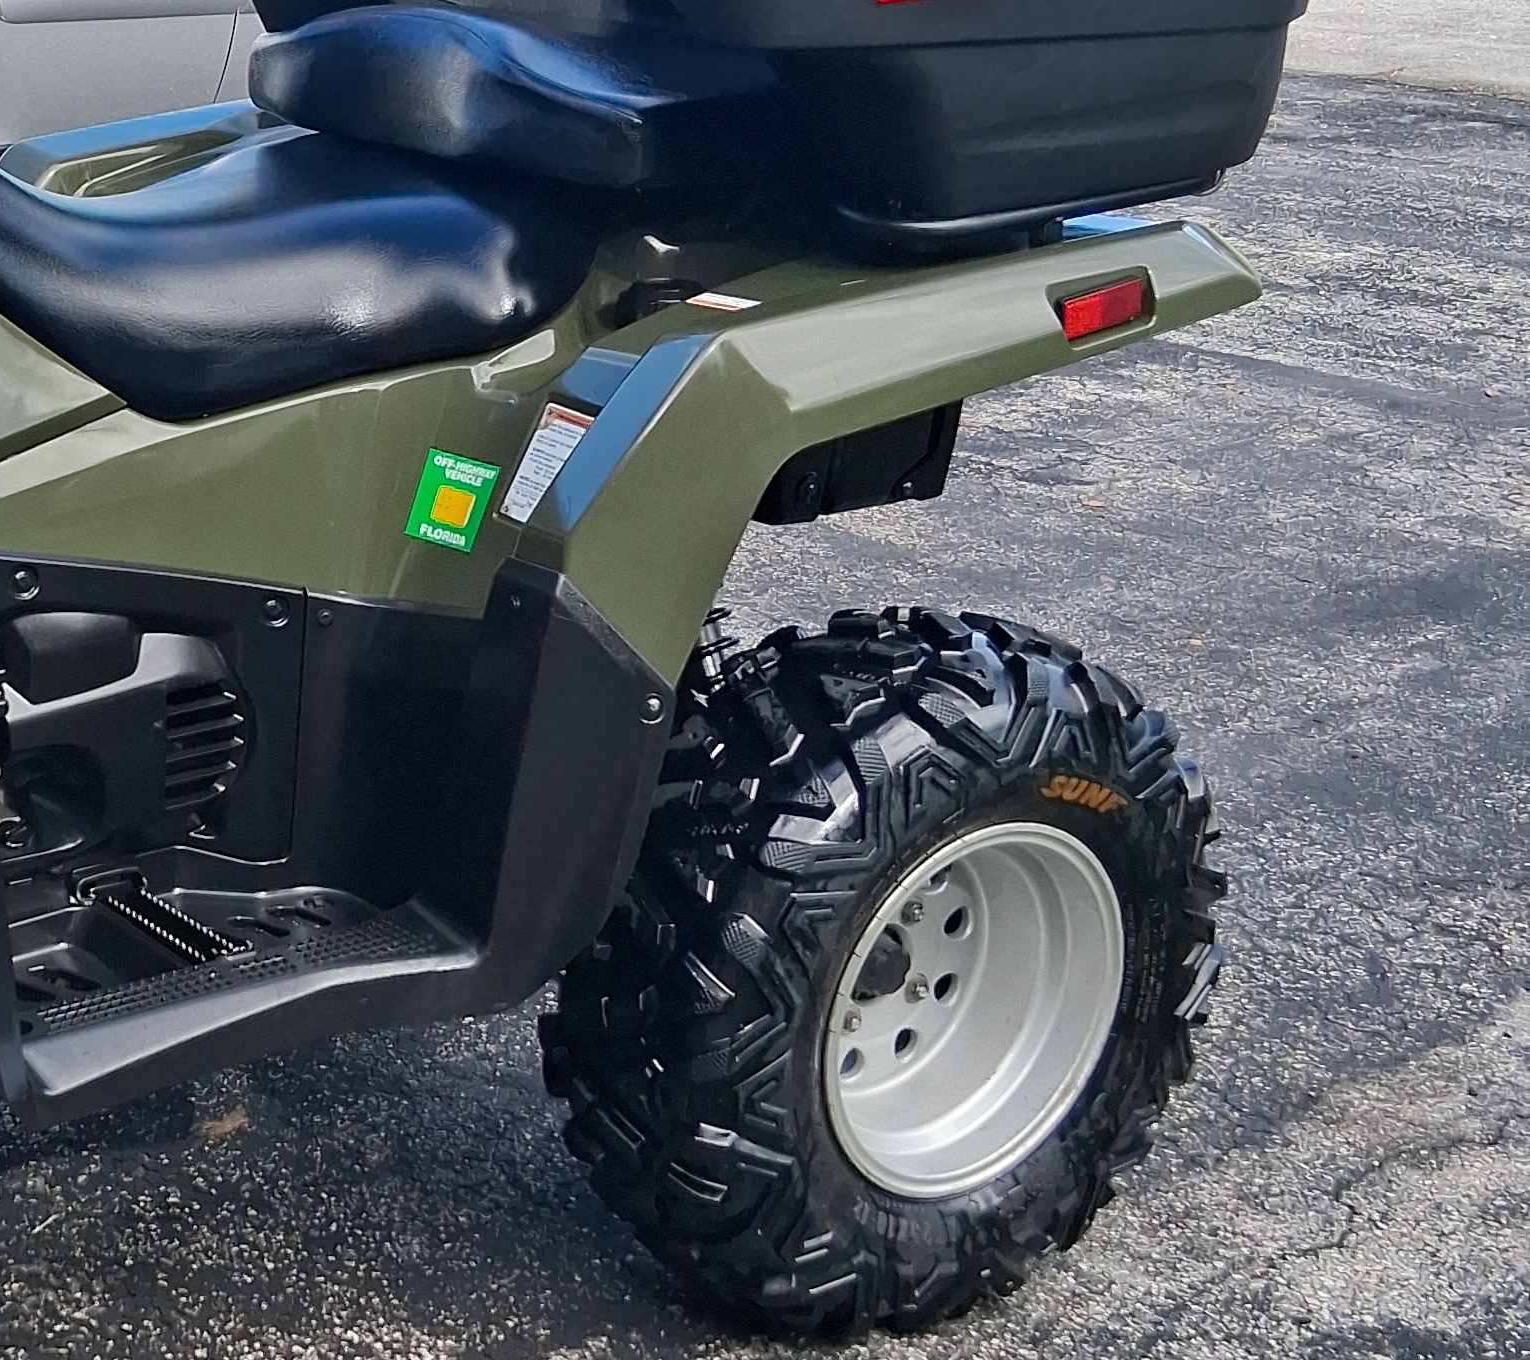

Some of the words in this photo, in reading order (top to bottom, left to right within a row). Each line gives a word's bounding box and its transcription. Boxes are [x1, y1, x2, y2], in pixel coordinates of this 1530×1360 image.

[433, 455, 497, 480] OFF-HIGHWAY
[445, 468, 484, 487] VEHICLE
[419, 523, 466, 547] FLORIDA
[1040, 774, 1129, 814] SUNF
